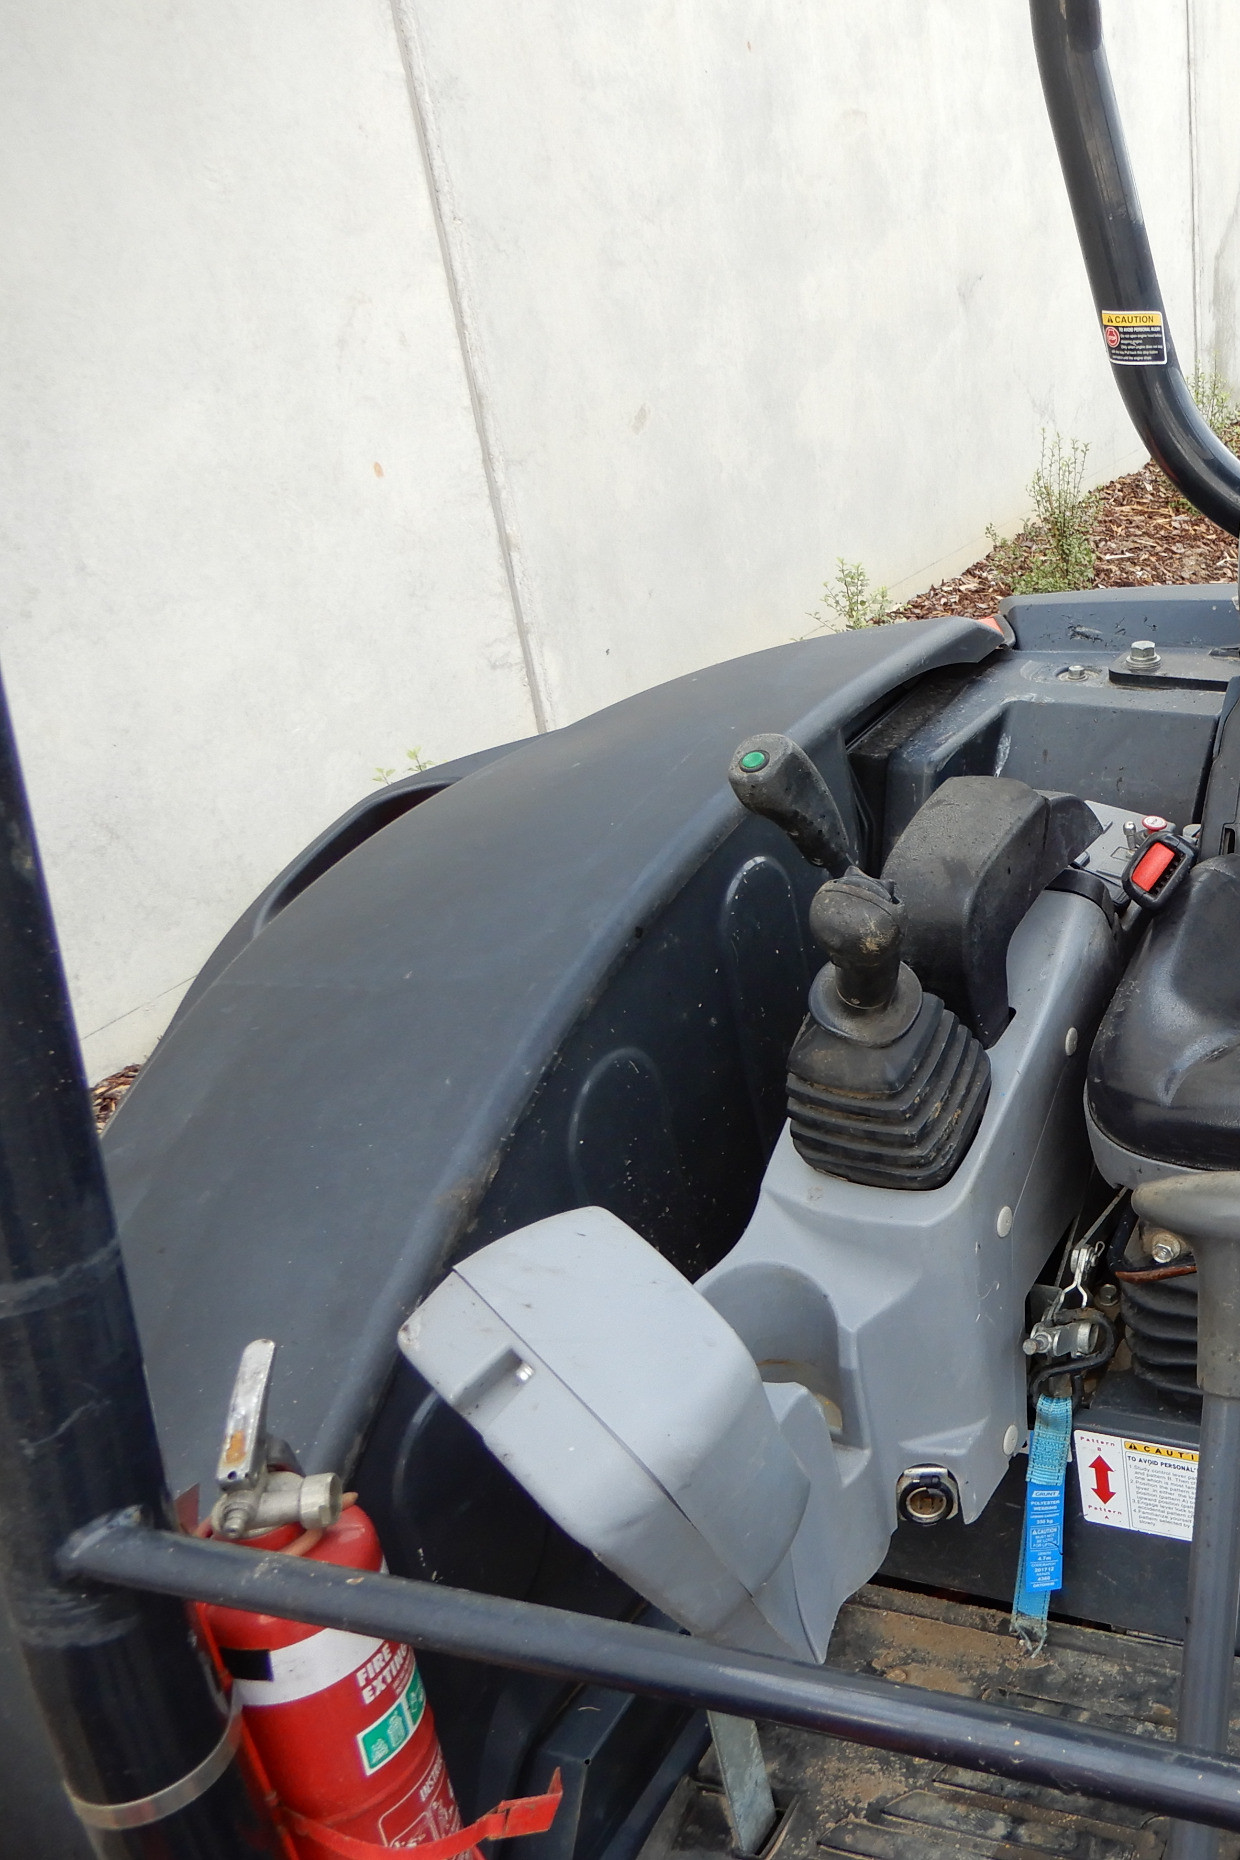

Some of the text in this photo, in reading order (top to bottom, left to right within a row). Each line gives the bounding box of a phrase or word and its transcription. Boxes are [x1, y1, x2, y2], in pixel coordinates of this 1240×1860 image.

[1114, 315, 1154, 324] CAUTION
[1080, 1436, 1115, 1446] Pattern
[1144, 1446, 1194, 1460] CAUTI
[1138, 1457, 1158, 1465] AVOID
[1160, 1462, 1195, 1472] PERSONAL
[1088, 1505, 1122, 1515] Pattern
[356, 1643, 392, 1687] FIRE
